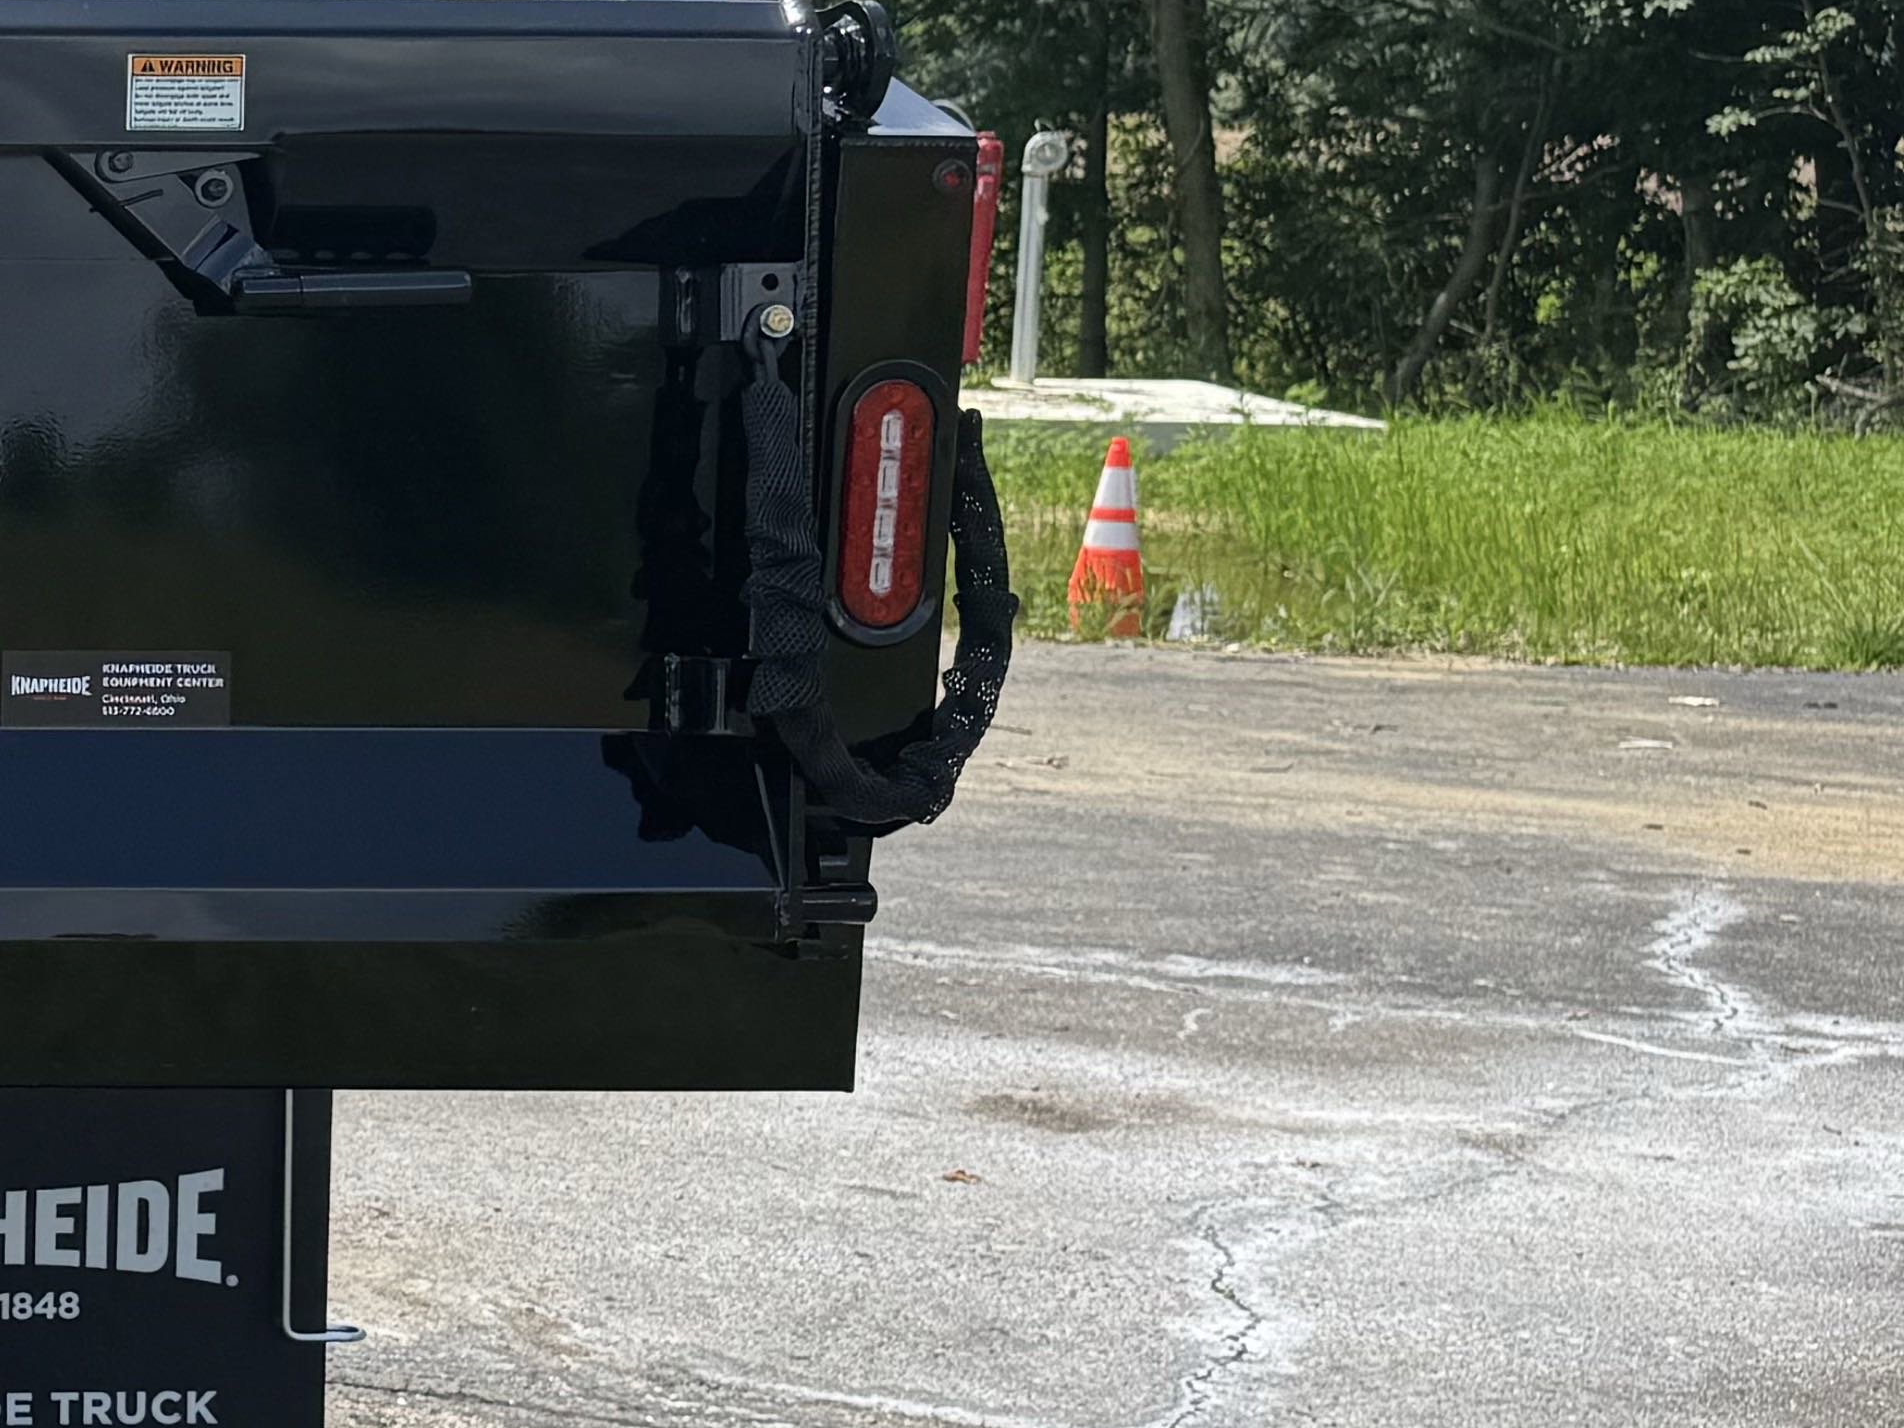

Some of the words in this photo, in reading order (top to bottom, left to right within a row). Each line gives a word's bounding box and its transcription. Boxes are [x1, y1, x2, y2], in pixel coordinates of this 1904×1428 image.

[159, 60, 234, 74] WARNING
[11, 674, 93, 696] KNAPHEIDE
[50, 1390, 219, 1426] TRUCK
